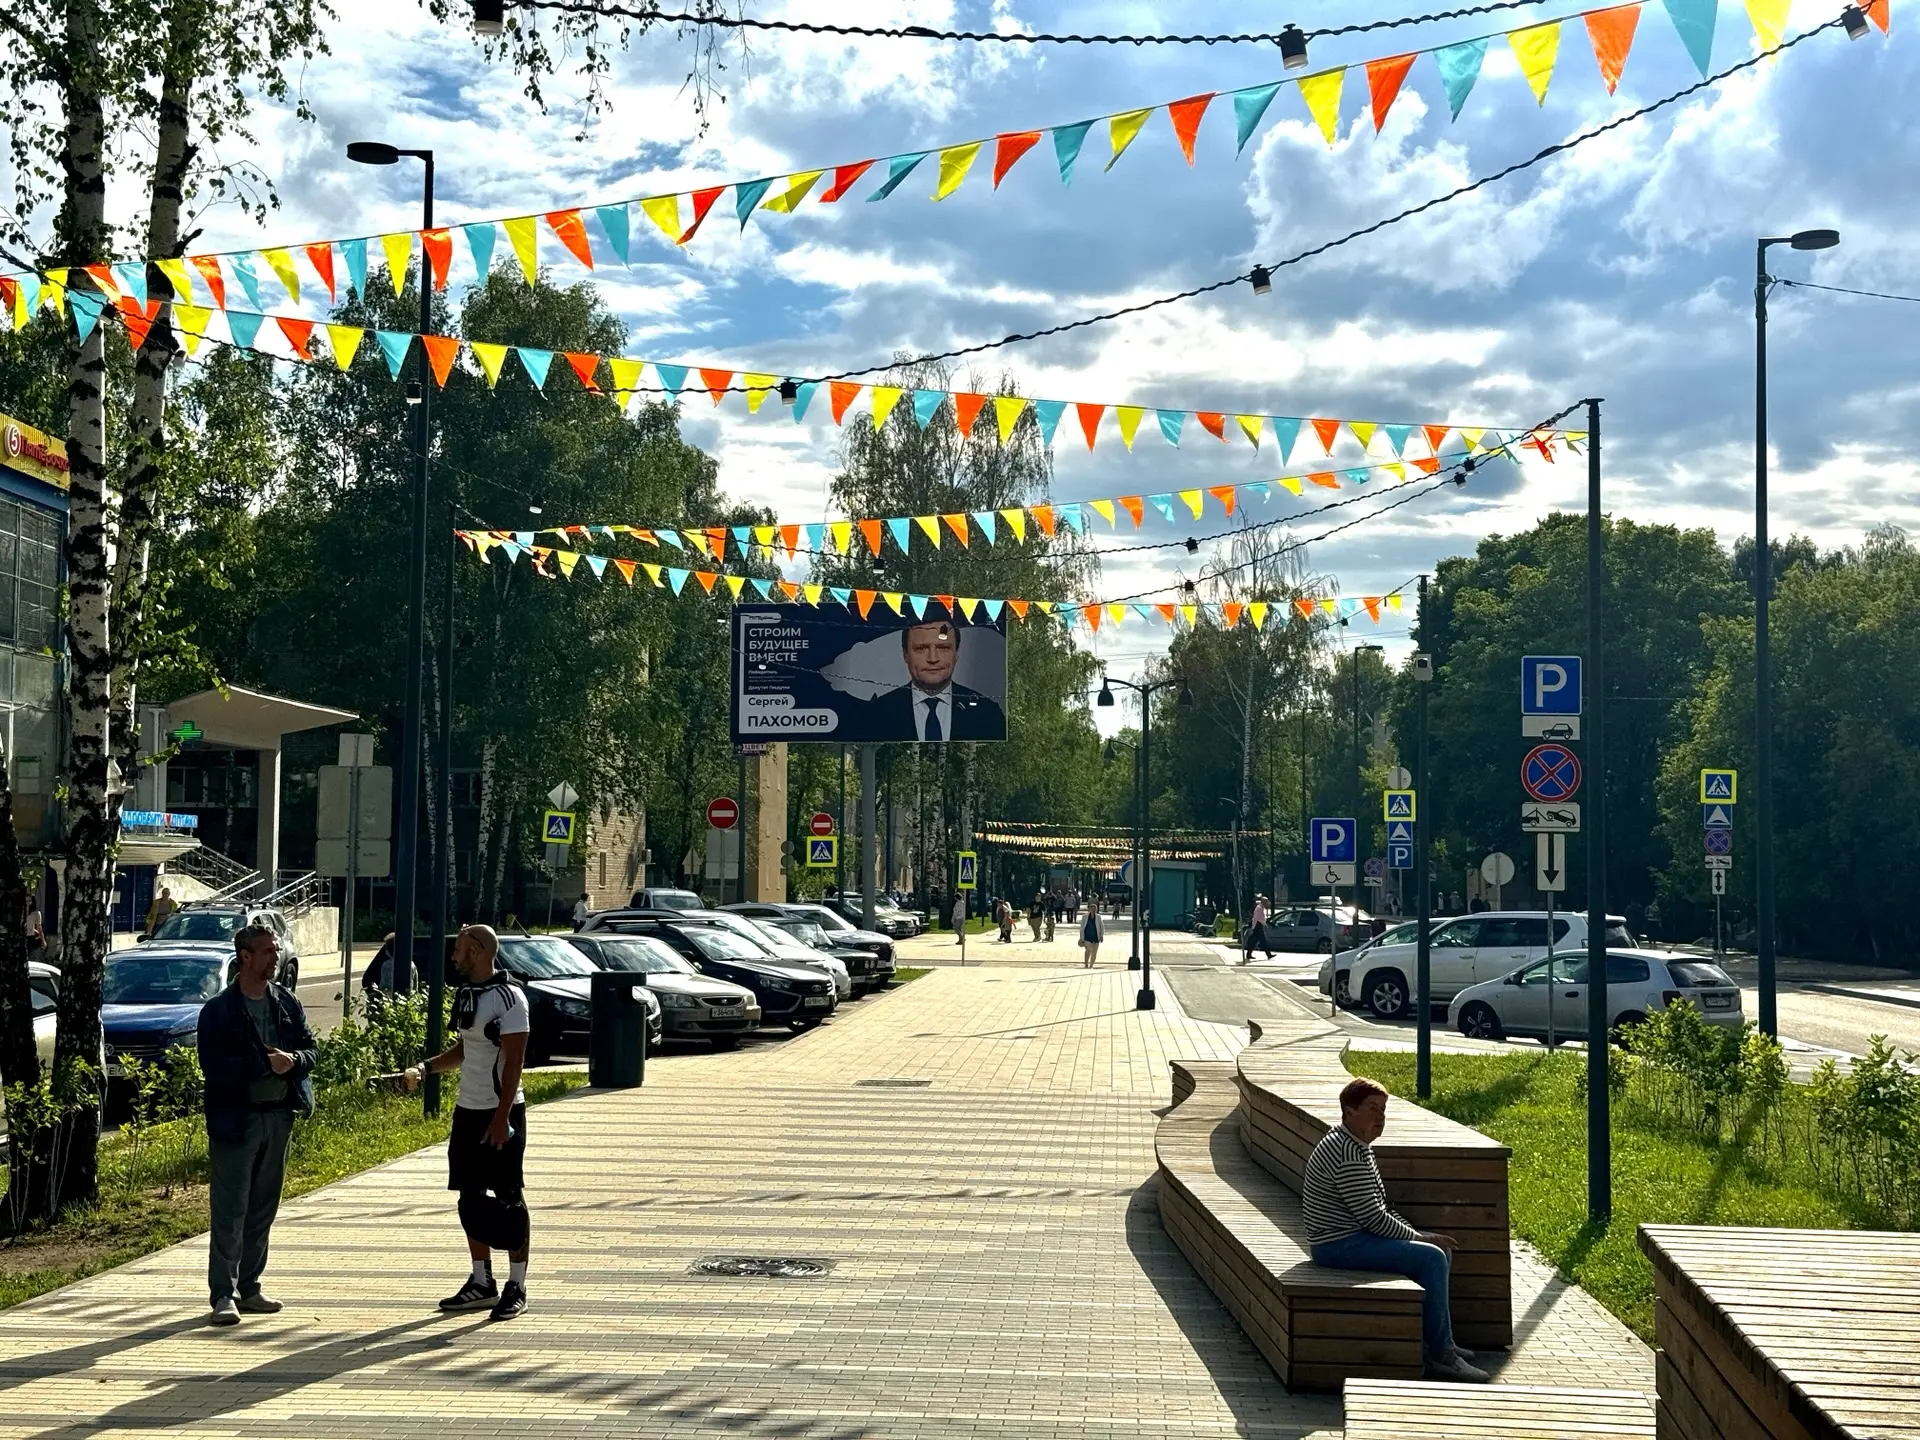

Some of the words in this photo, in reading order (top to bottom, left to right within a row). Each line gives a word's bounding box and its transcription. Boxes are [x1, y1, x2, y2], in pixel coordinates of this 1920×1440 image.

[749, 627, 801, 637] СТРОИМ
[749, 640, 810, 651] БУДУЩЕЕ
[749, 652, 798, 662] ВМЕСТЕ
[1535, 663, 1568, 708] P
[748, 696, 789, 708] Сергей
[748, 715, 829, 727] ПАХОМОВ
[1321, 823, 1345, 858] P
[1394, 847, 1409, 866] P
